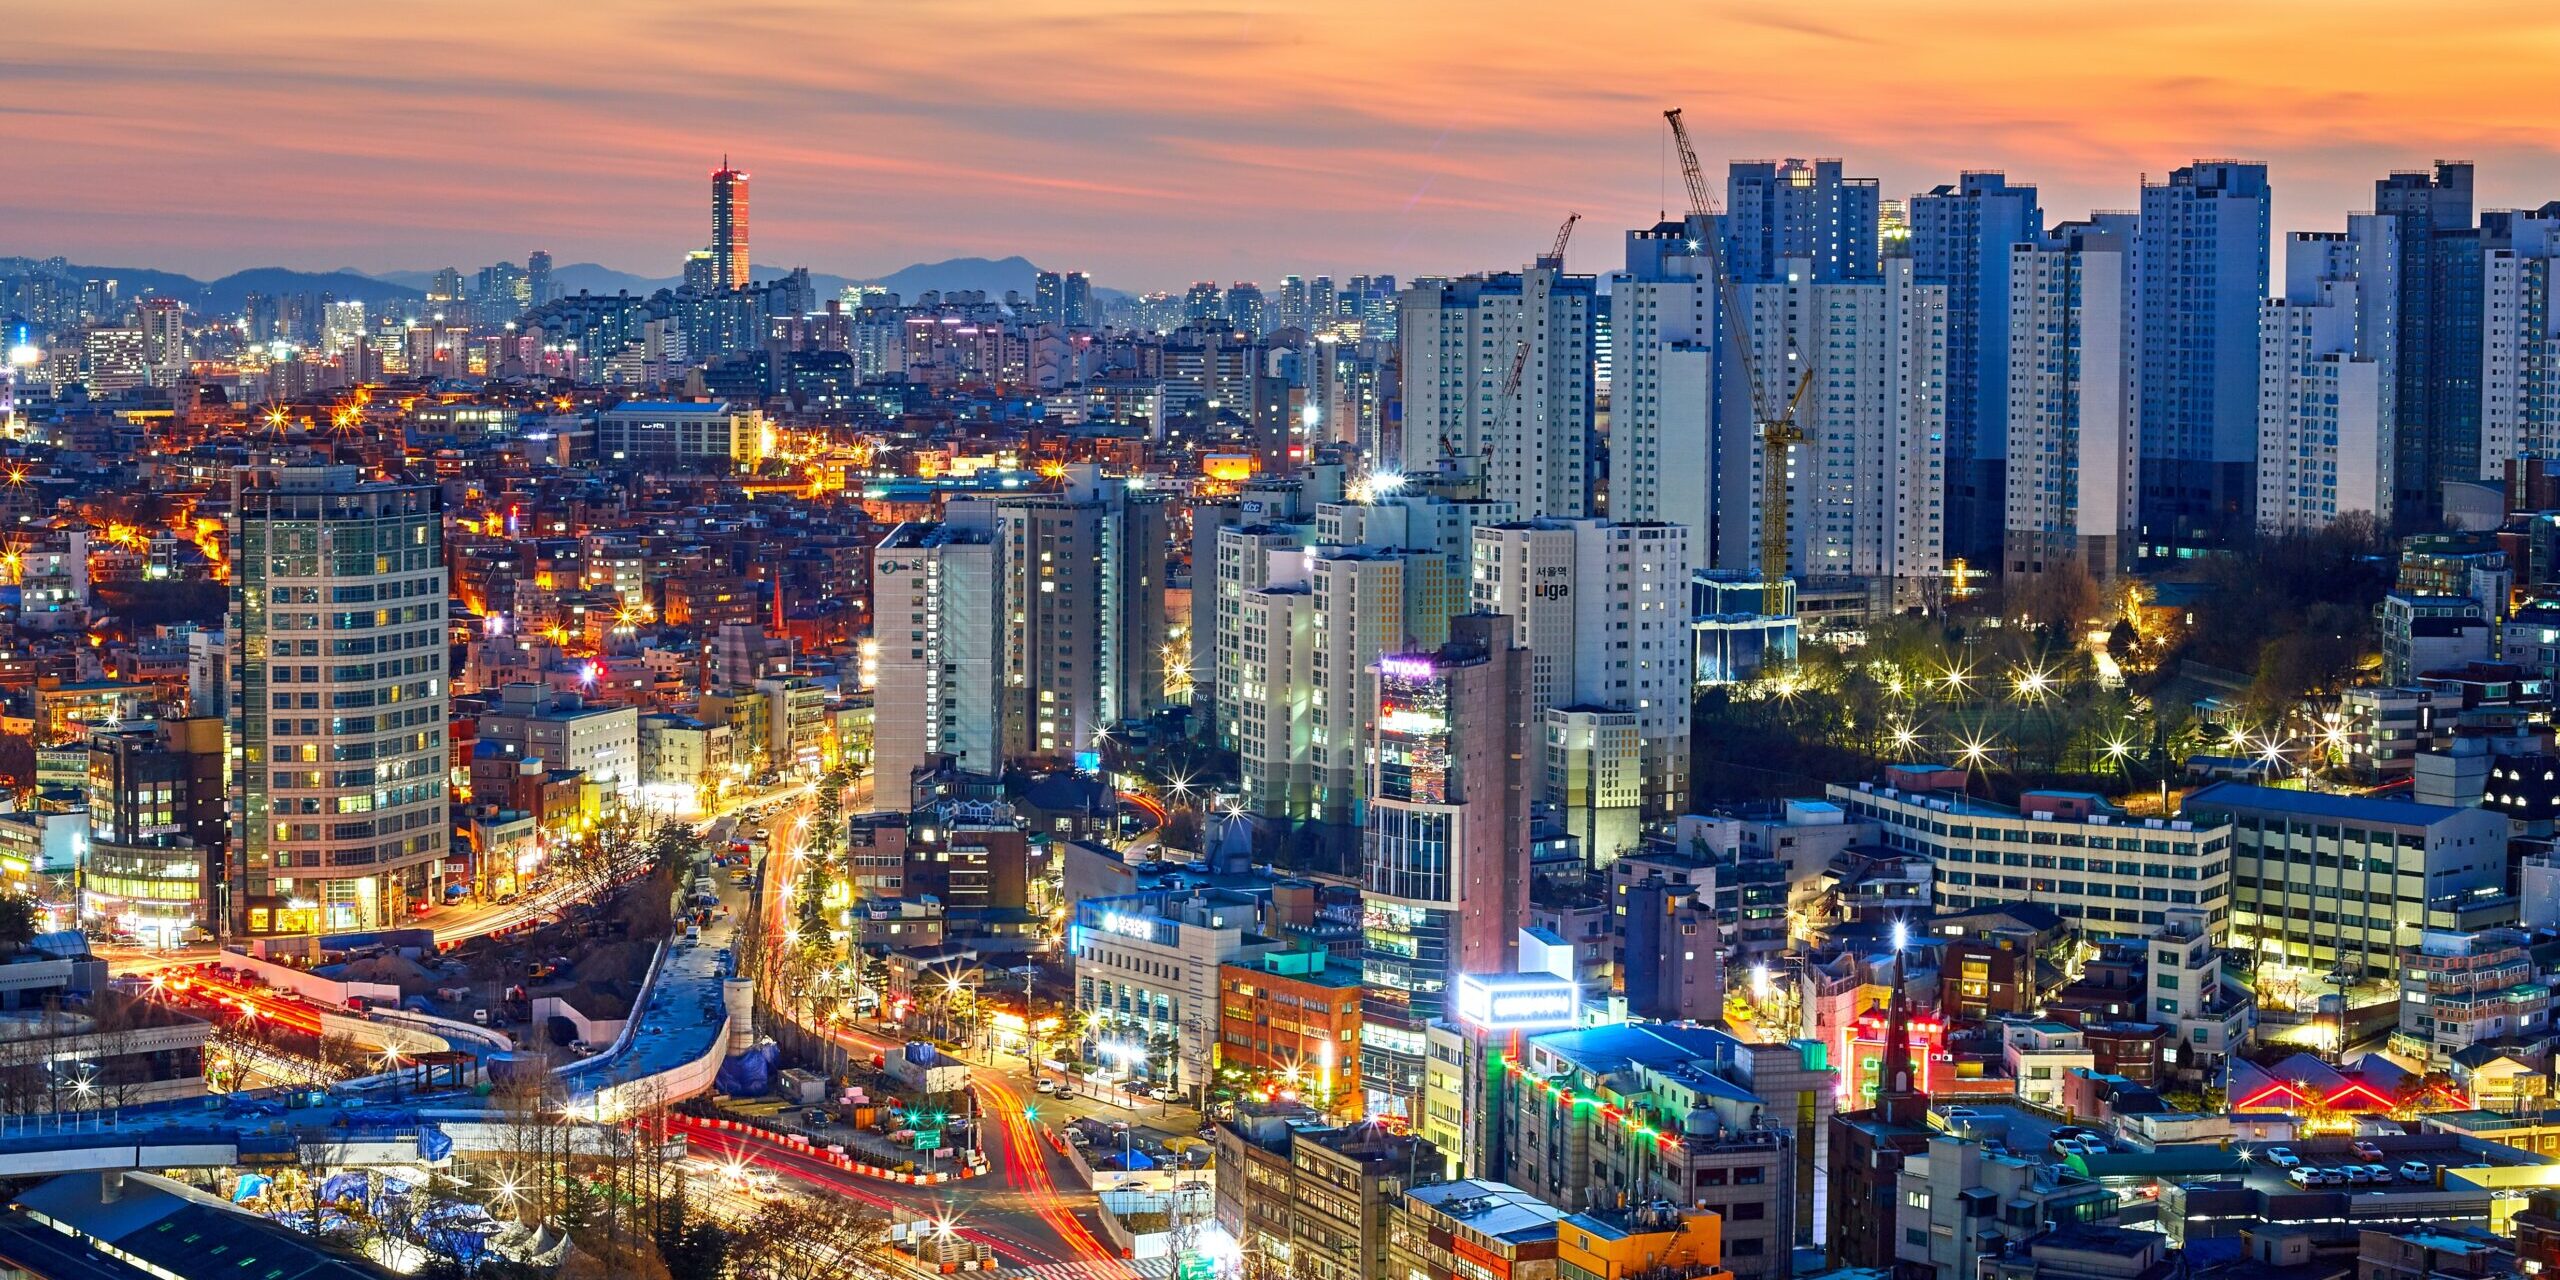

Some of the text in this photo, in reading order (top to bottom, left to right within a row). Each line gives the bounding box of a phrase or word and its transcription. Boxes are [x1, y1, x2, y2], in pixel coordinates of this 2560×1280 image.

[1243, 502, 1260, 512] KCC
[1536, 566, 1567, 578] 서울역
[1535, 580, 1568, 602] Liga
